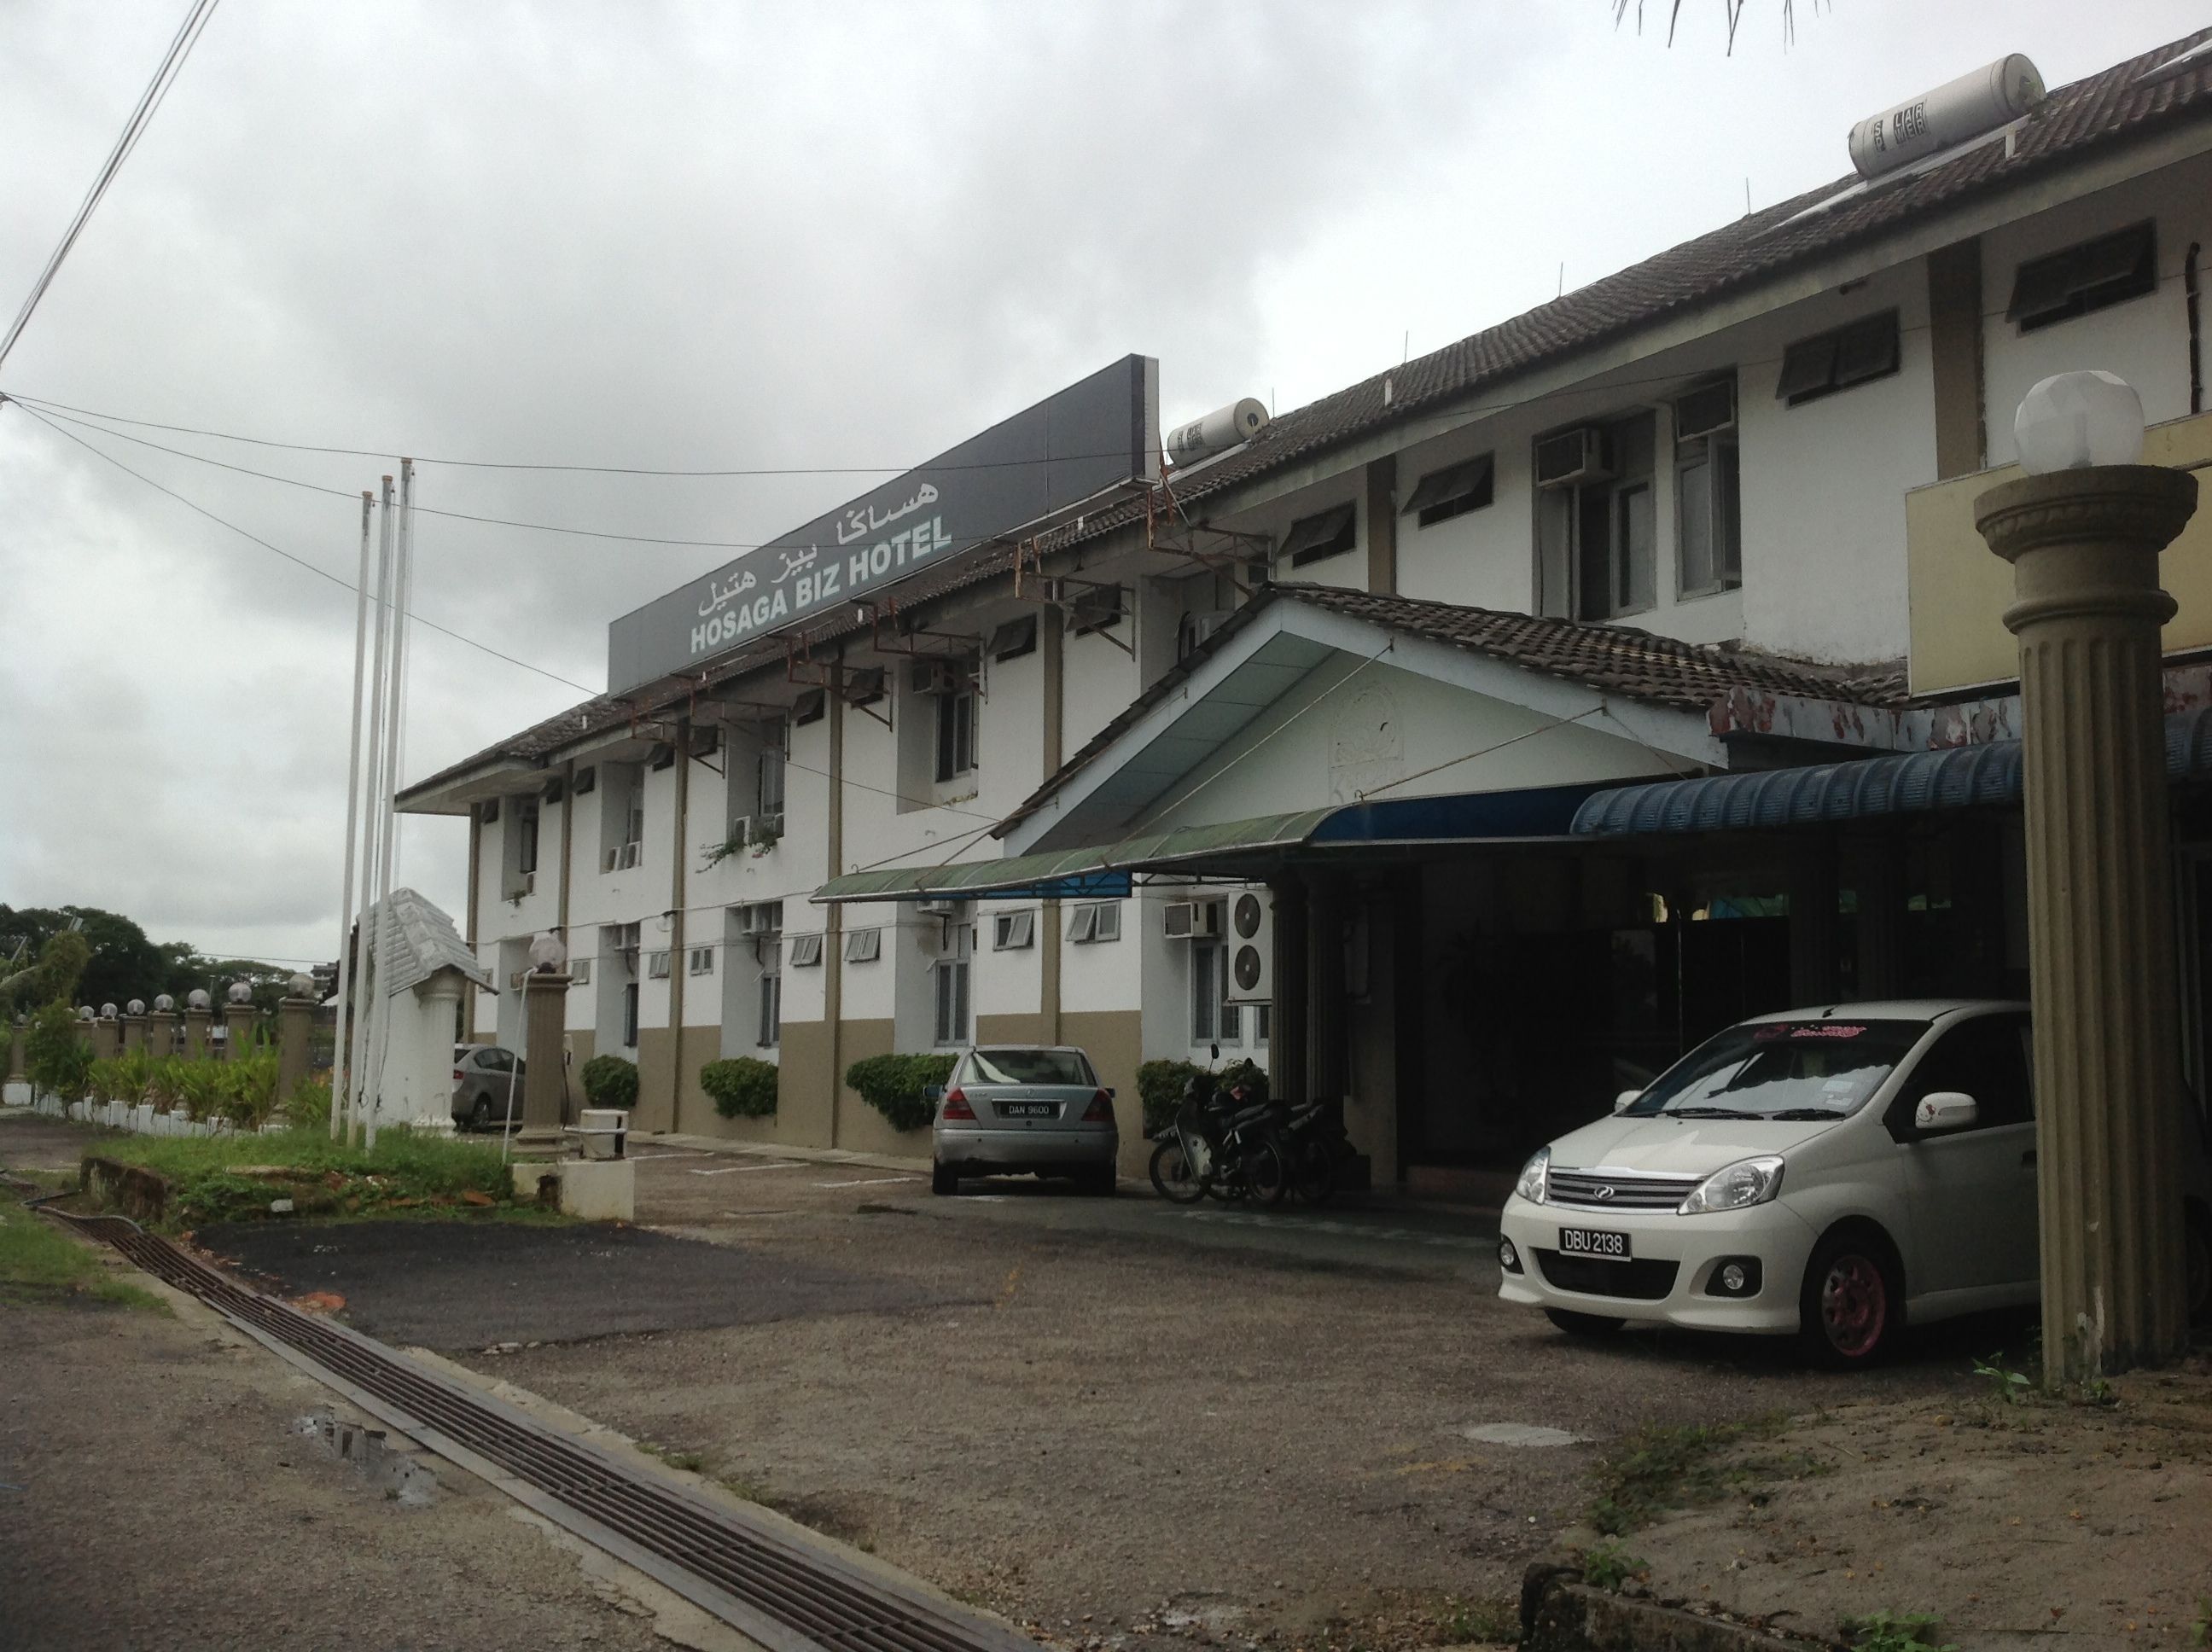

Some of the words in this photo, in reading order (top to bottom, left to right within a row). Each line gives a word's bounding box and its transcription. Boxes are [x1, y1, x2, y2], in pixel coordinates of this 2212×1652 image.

[690, 589, 788, 654] HOSAGA
[795, 562, 841, 608] BIZ
[849, 515, 952, 586] HOTEL
[1009, 1105, 1025, 1114] DAN
[1027, 1105, 1049, 1114] 9600
[1564, 1230, 1591, 1250] DBU
[1592, 1232, 1623, 1254] 2138
